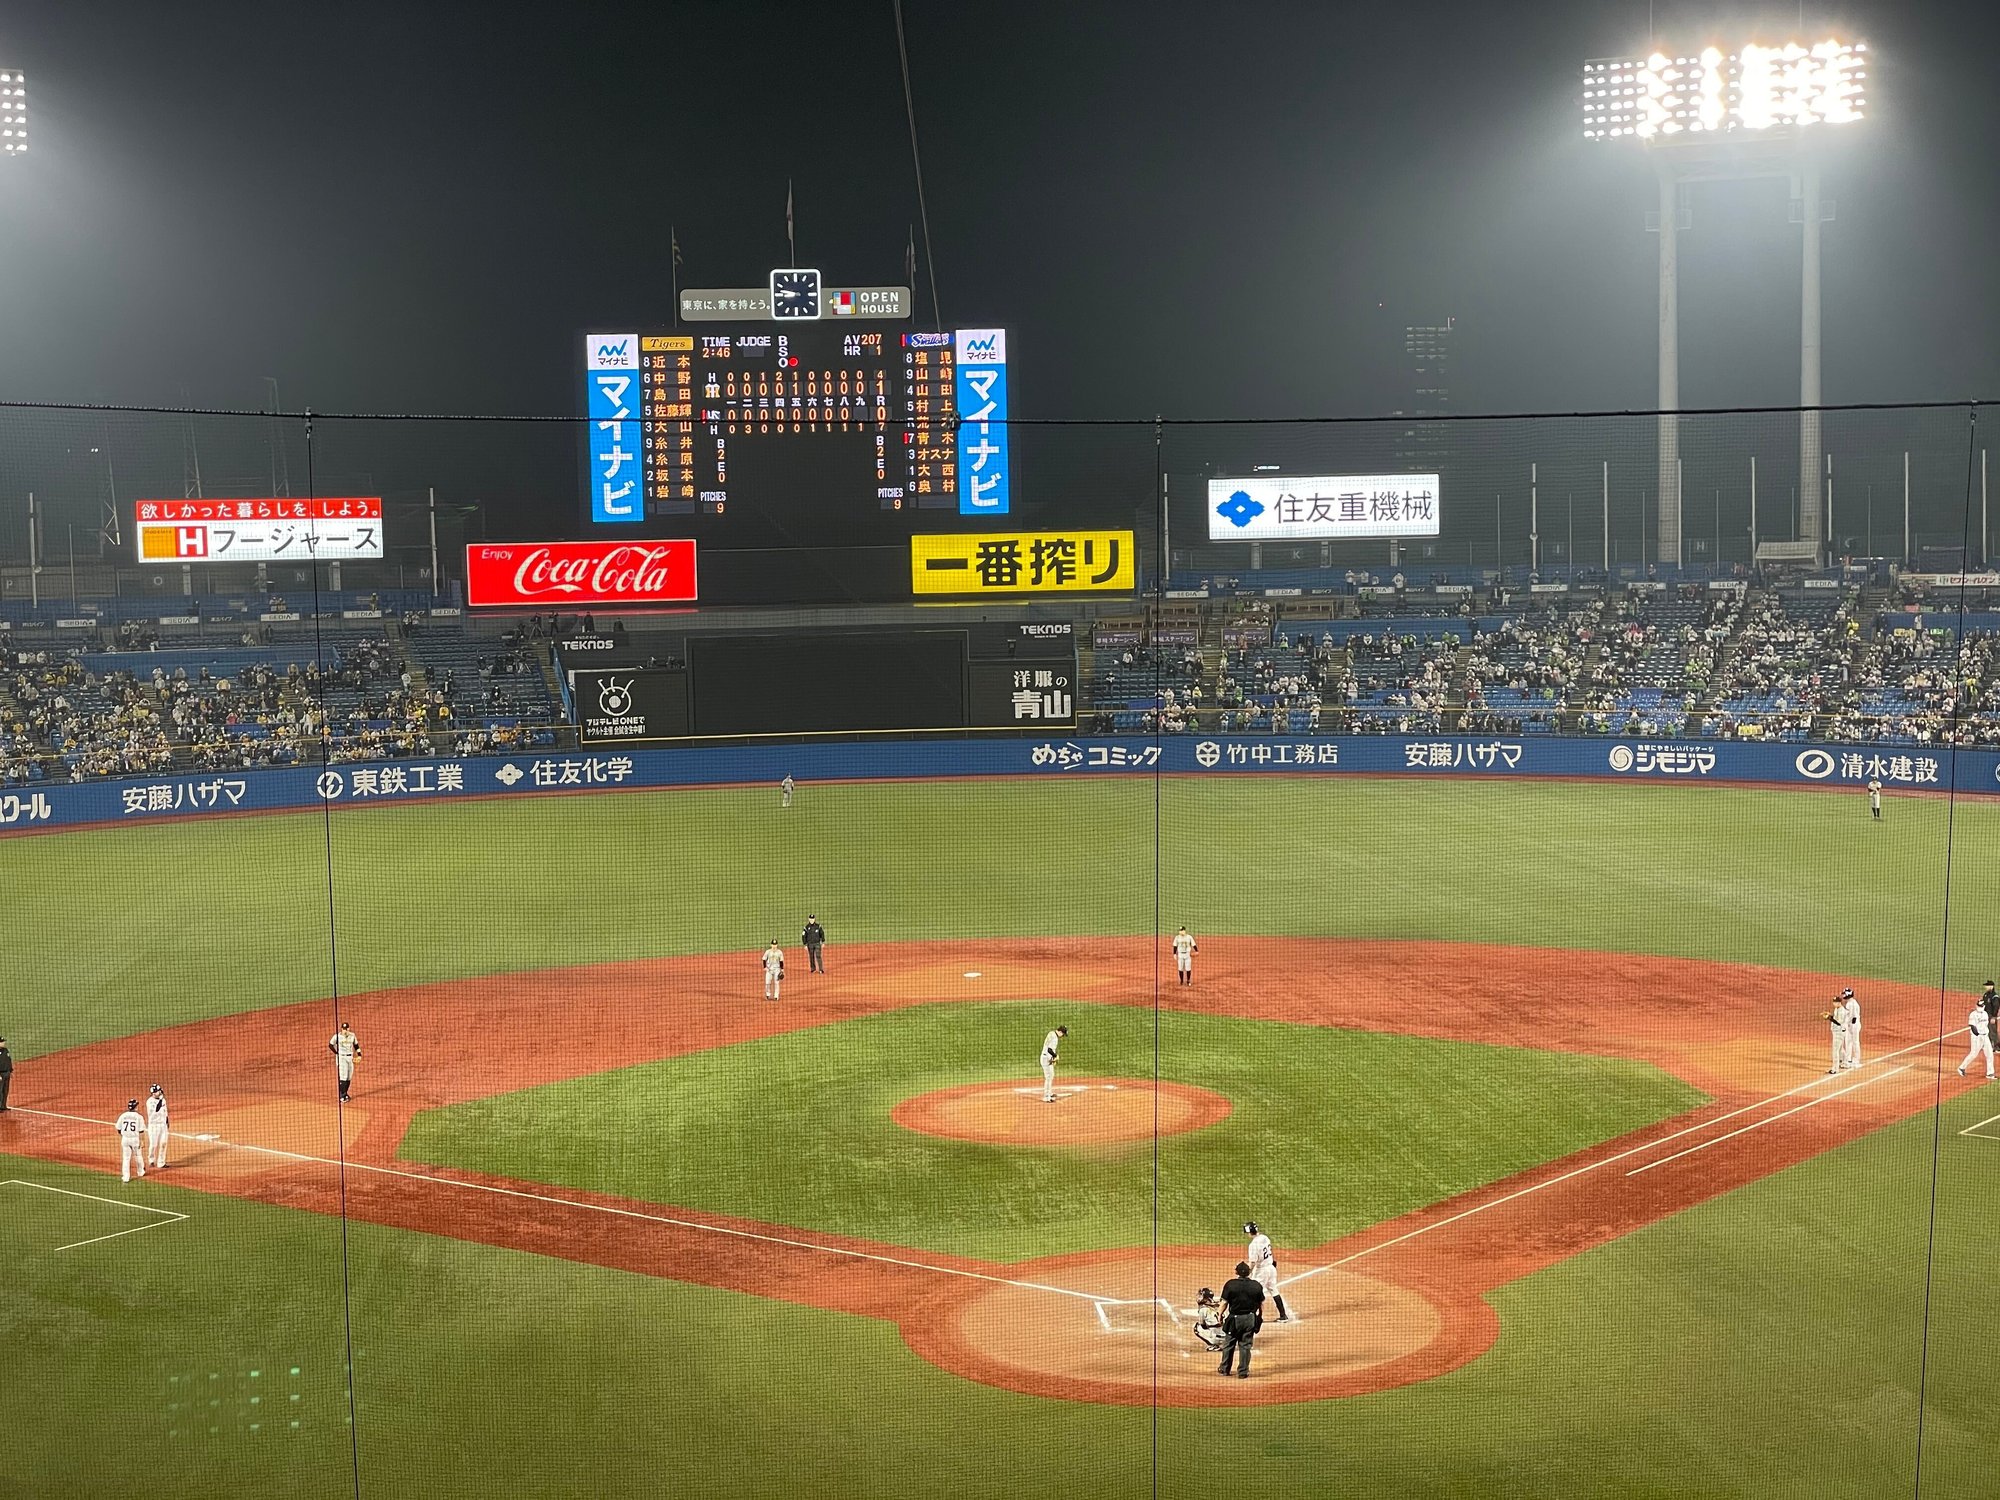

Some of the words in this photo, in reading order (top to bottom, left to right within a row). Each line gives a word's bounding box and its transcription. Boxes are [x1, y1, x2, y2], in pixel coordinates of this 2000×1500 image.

[860, 292, 899, 302] OPEN
[682, 299, 771, 310] 東京に、家を持とう。
[861, 304, 899, 314] HOUSE
[650, 338, 686, 350] Tigers
[702, 336, 730, 347] TIME
[736, 336, 772, 347] JUDGE
[778, 336, 788, 346] B
[844, 335, 860, 345] AV
[861, 334, 882, 344] 207
[702, 347, 730, 358] 2:46
[778, 347, 788, 356] S
[844, 346, 861, 356] HR
[966, 352, 996, 360] マイナビ
[598, 358, 629, 366] マイナビ
[644, 356, 650, 368] 8
[778, 358, 788, 368] O
[906, 352, 913, 364] 8
[644, 373, 650, 384] 6
[708, 372, 716, 382] H
[727, 372, 734, 382] 0
[744, 372, 750, 381] 0
[760, 372, 765, 381] 1
[775, 372, 783, 380] 2
[793, 372, 798, 380] 1
[808, 371, 815, 380] 0
[824, 371, 831, 380] 0
[840, 370, 847, 380] 0
[856, 370, 863, 380] 0
[877, 370, 884, 379] 4
[906, 369, 914, 380] 9
[727, 384, 735, 396] 0
[744, 384, 751, 396] 0
[760, 383, 767, 396] 0
[776, 383, 784, 395] 0
[792, 382, 798, 395] 1
[808, 382, 816, 395] 0
[824, 382, 832, 395] 0
[840, 382, 848, 394] 0
[856, 382, 864, 394] 0
[876, 380, 884, 395] 1
[907, 386, 914, 396] 4
[644, 390, 651, 400] 7
[742, 398, 752, 407] 二
[758, 398, 769, 407] 三
[775, 398, 784, 408] 四
[791, 398, 802, 406] 五
[808, 397, 818, 406] 六
[824, 397, 834, 406] 七
[840, 396, 850, 406] 八
[856, 396, 866, 406] 九
[876, 396, 885, 406] R
[908, 401, 914, 412] 5
[644, 406, 652, 416] 5
[654, 404, 692, 417] 佐藤輝
[728, 410, 736, 421] 0
[744, 410, 752, 421] 0
[760, 410, 768, 421] 0
[776, 409, 784, 421] 0
[793, 408, 800, 421] 0
[809, 408, 816, 421] 0
[825, 408, 832, 421] 0
[841, 408, 848, 421] 0
[878, 406, 886, 421] 0
[645, 422, 652, 432] 3
[710, 425, 718, 434] H
[728, 425, 736, 434] 0
[745, 425, 752, 434] 3
[761, 424, 768, 434] 0
[777, 424, 784, 433] 0
[794, 424, 800, 432] 0
[810, 424, 815, 432] 1
[826, 424, 831, 432] 1
[842, 423, 847, 432] 1
[858, 423, 863, 432] 1
[878, 422, 884, 432] 7
[646, 438, 652, 448] 9
[717, 438, 724, 448] B
[876, 436, 884, 446] B
[908, 433, 914, 443] 7
[965, 370, 1002, 506] マイナビ
[597, 376, 636, 514] マイナビ
[718, 449, 724, 460] 2
[877, 447, 884, 457] 2
[908, 450, 916, 460] 3
[918, 448, 954, 460] オスナ
[646, 454, 653, 465] 4
[877, 459, 884, 468] E
[718, 462, 726, 472] E
[647, 470, 654, 480] 2
[718, 472, 726, 482] 0
[878, 470, 884, 480] 0
[909, 482, 916, 492] 6
[700, 492, 726, 502] PITCHES
[878, 488, 904, 498] PITCHES
[717, 502, 724, 513] 9
[894, 500, 902, 510] 9
[1274, 490, 1433, 524] 住友重機械
[213, 525, 378, 554] フージャース
[481, 549, 514, 560] Enjoy
[926, 538, 1120, 586] 一番搾り
[513, 546, 671, 595] Coca-Cola
[1020, 624, 1072, 635] TEKNOS
[562, 640, 614, 650] TEKNOS
[1014, 670, 1068, 688] 洋服の
[1011, 690, 1072, 719] 青山
[1031, 743, 1162, 768] めちゃコミック
[1226, 744, 1338, 765] 竹中工務店
[1404, 741, 1522, 768] 安藤ハザマ
[1636, 752, 1716, 774] シモジマ
[1840, 752, 1938, 783] 清水建設
[530, 756, 634, 786] 住友化学
[351, 764, 464, 797] 東鉄工業
[122, 778, 246, 814] 安藤ハザマ
[123, 1121, 136, 1132] 75
